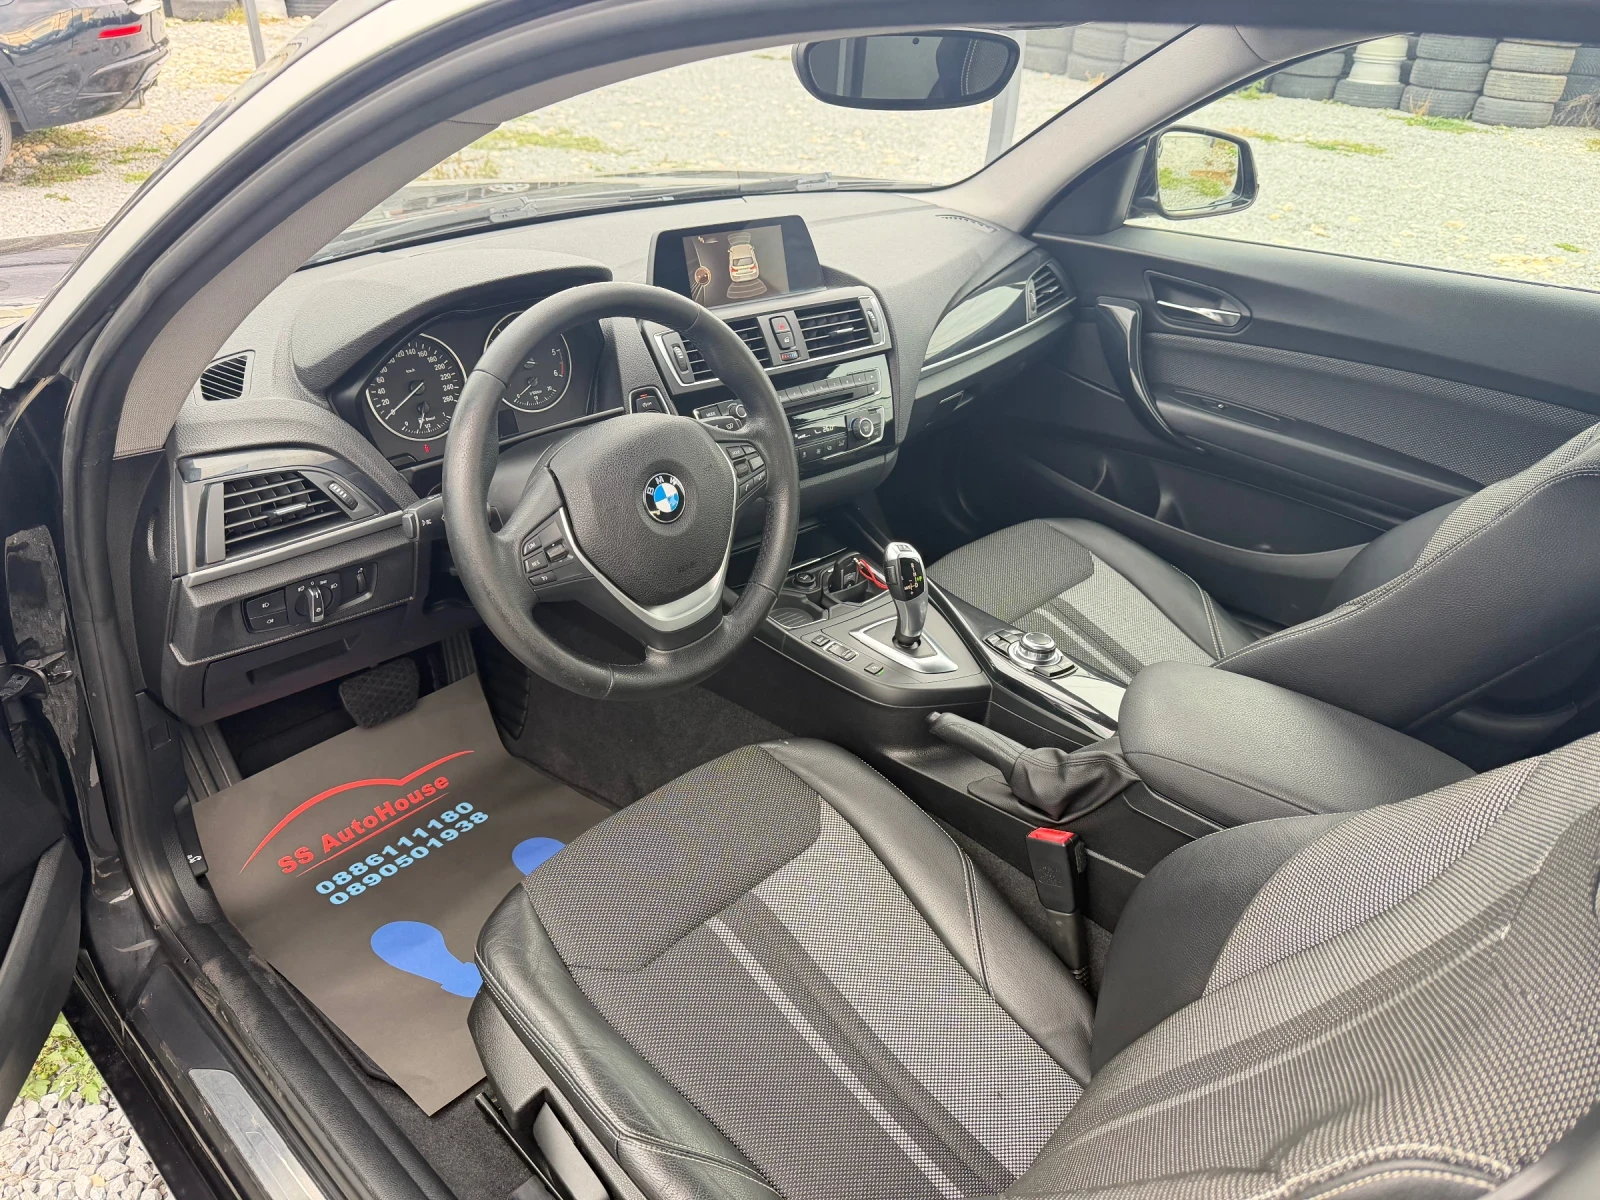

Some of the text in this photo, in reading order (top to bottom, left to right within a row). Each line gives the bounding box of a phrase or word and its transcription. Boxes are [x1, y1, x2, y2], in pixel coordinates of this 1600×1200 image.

[442, 384, 454, 392] 240
[646, 475, 680, 496] BMW
[278, 775, 449, 873] SS AutoHouse
[316, 802, 473, 894] 0886111180
[330, 812, 488, 905] 0890501938
